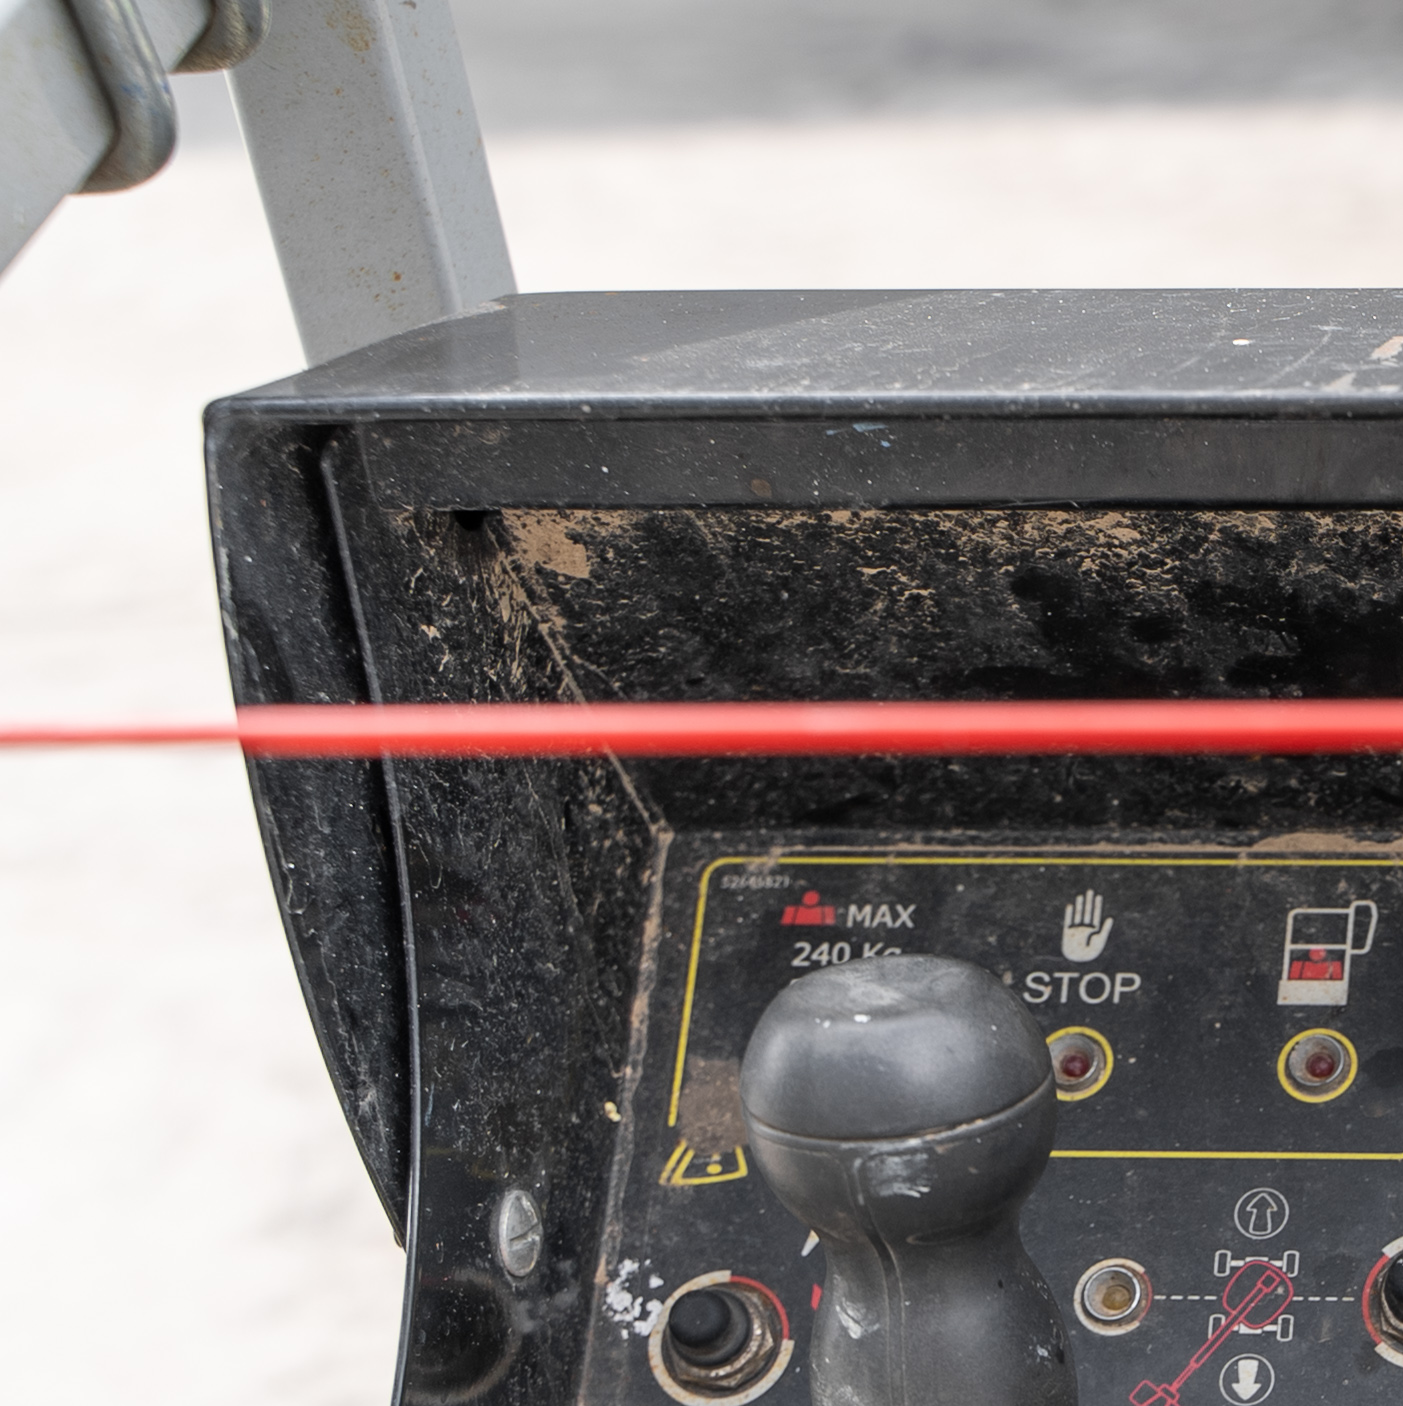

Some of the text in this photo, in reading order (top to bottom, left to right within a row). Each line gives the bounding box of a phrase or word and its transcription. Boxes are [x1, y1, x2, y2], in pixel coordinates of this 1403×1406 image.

[846, 903, 917, 929] MAX
[790, 941, 852, 967] 240
[1022, 971, 1142, 1004] STOP
